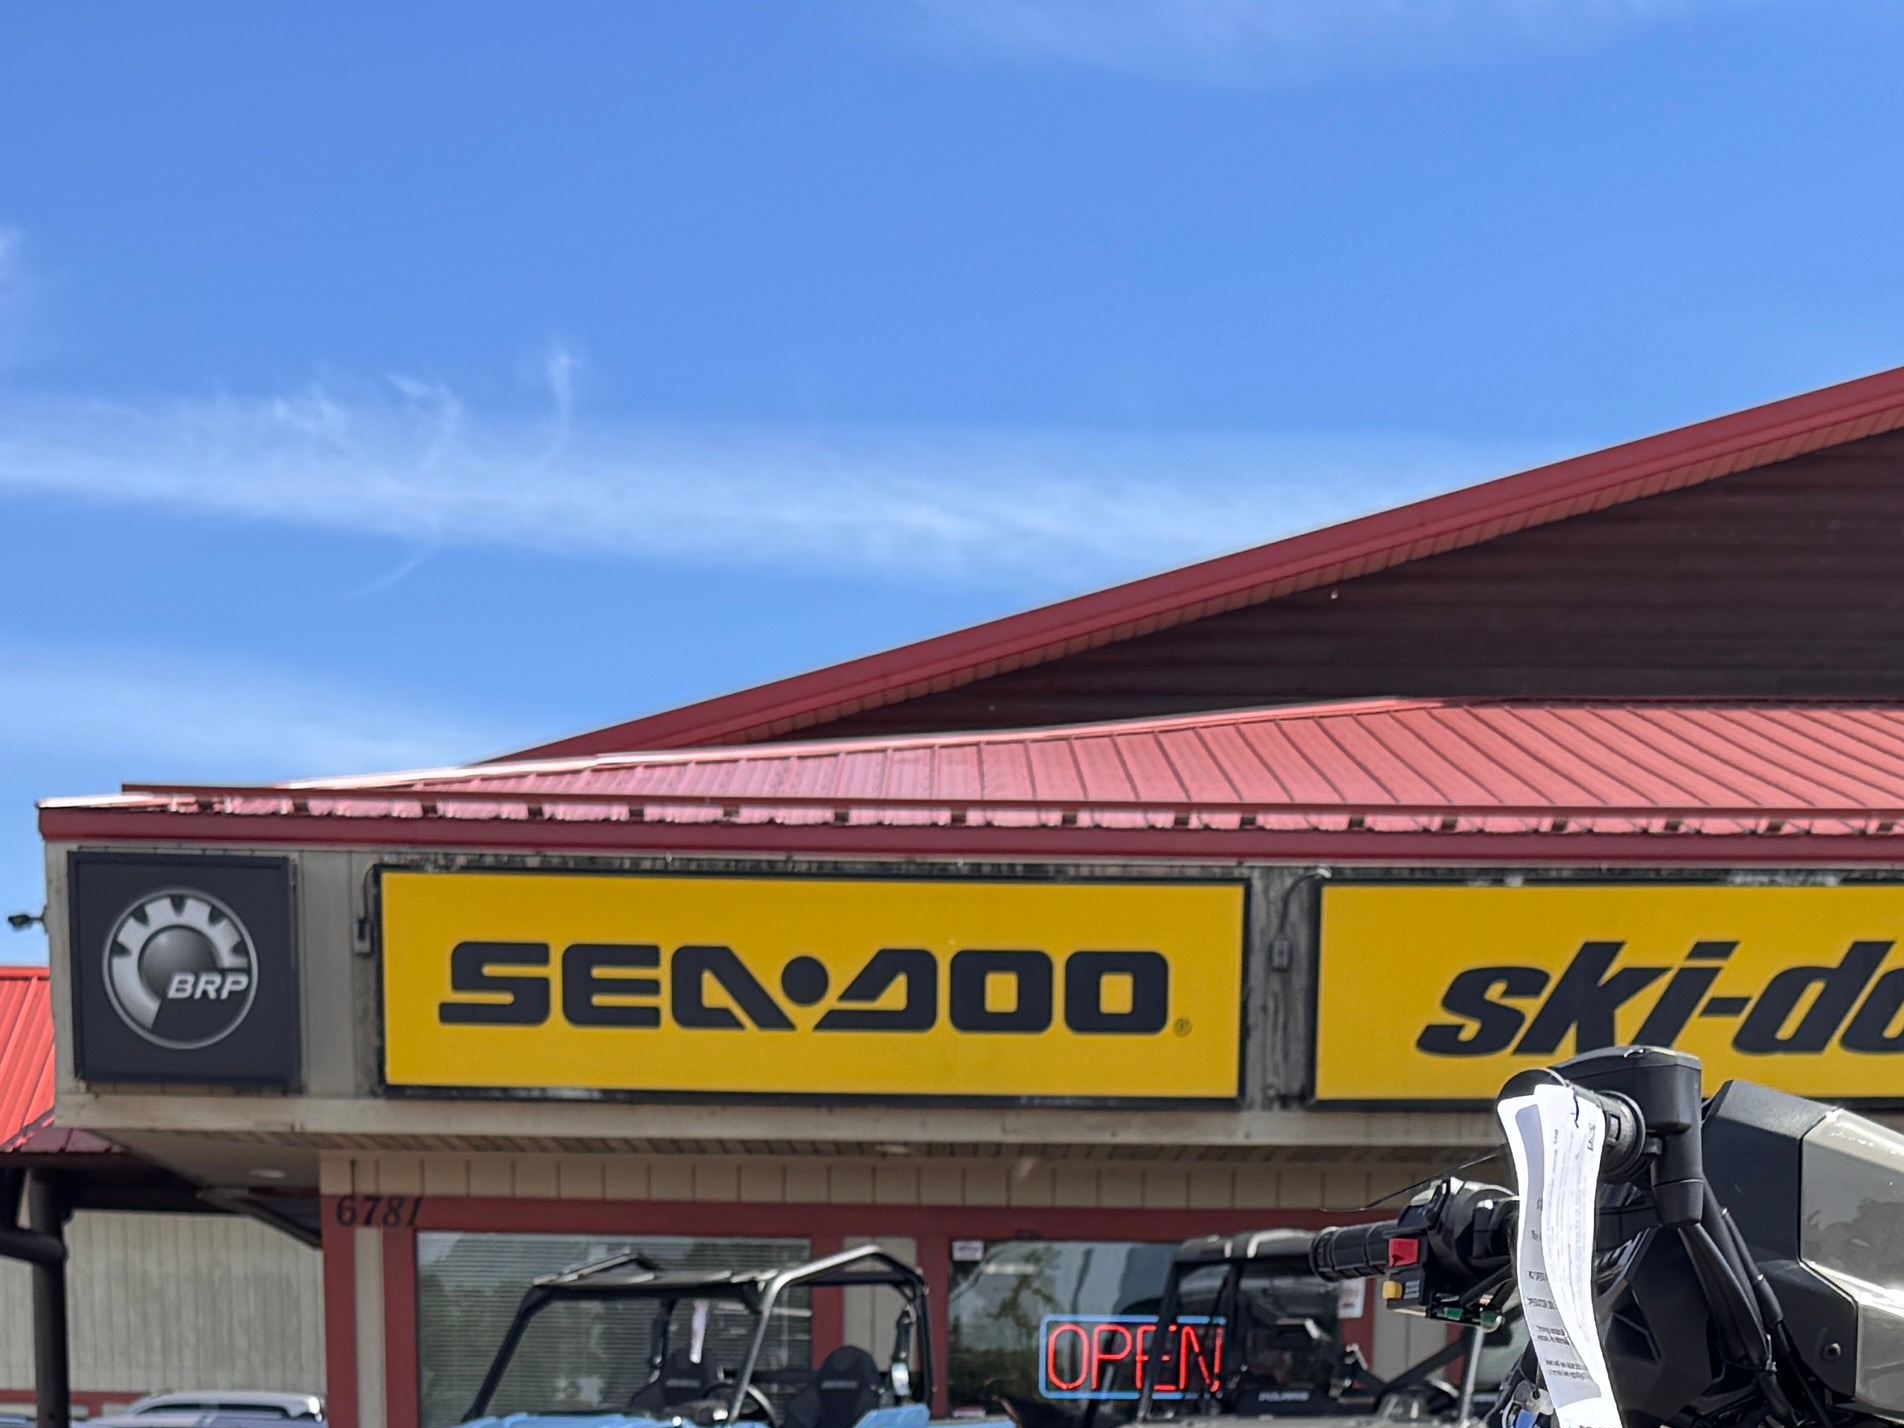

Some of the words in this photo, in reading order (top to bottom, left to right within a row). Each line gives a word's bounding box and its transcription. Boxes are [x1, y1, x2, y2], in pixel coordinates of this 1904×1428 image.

[167, 972, 249, 999] BRP
[336, 1194, 422, 1226] 6781
[1047, 1323, 1224, 1392] OPEN
